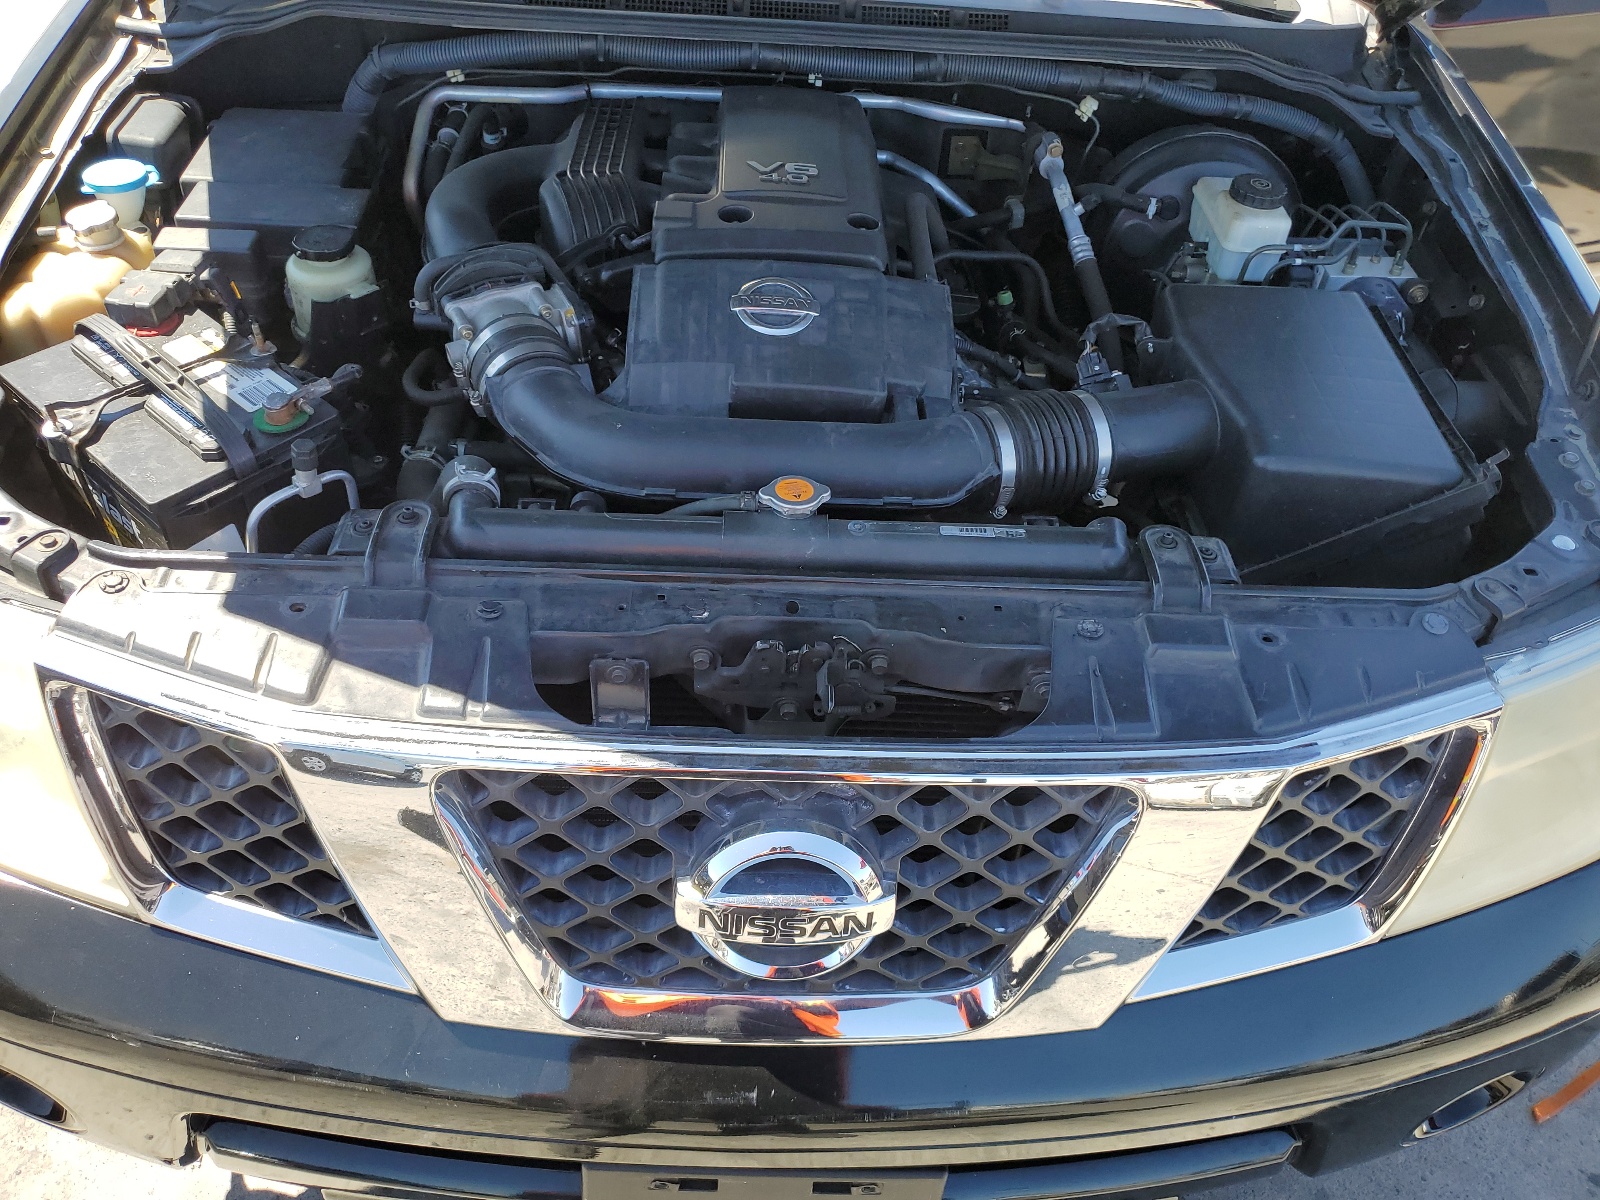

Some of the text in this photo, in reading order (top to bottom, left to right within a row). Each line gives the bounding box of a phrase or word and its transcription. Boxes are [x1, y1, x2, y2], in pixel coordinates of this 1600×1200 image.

[746, 160, 819, 176] V6
[758, 172, 810, 184] 4.0
[740, 295, 812, 308] NISSAN
[698, 911, 874, 938] NISSAN
